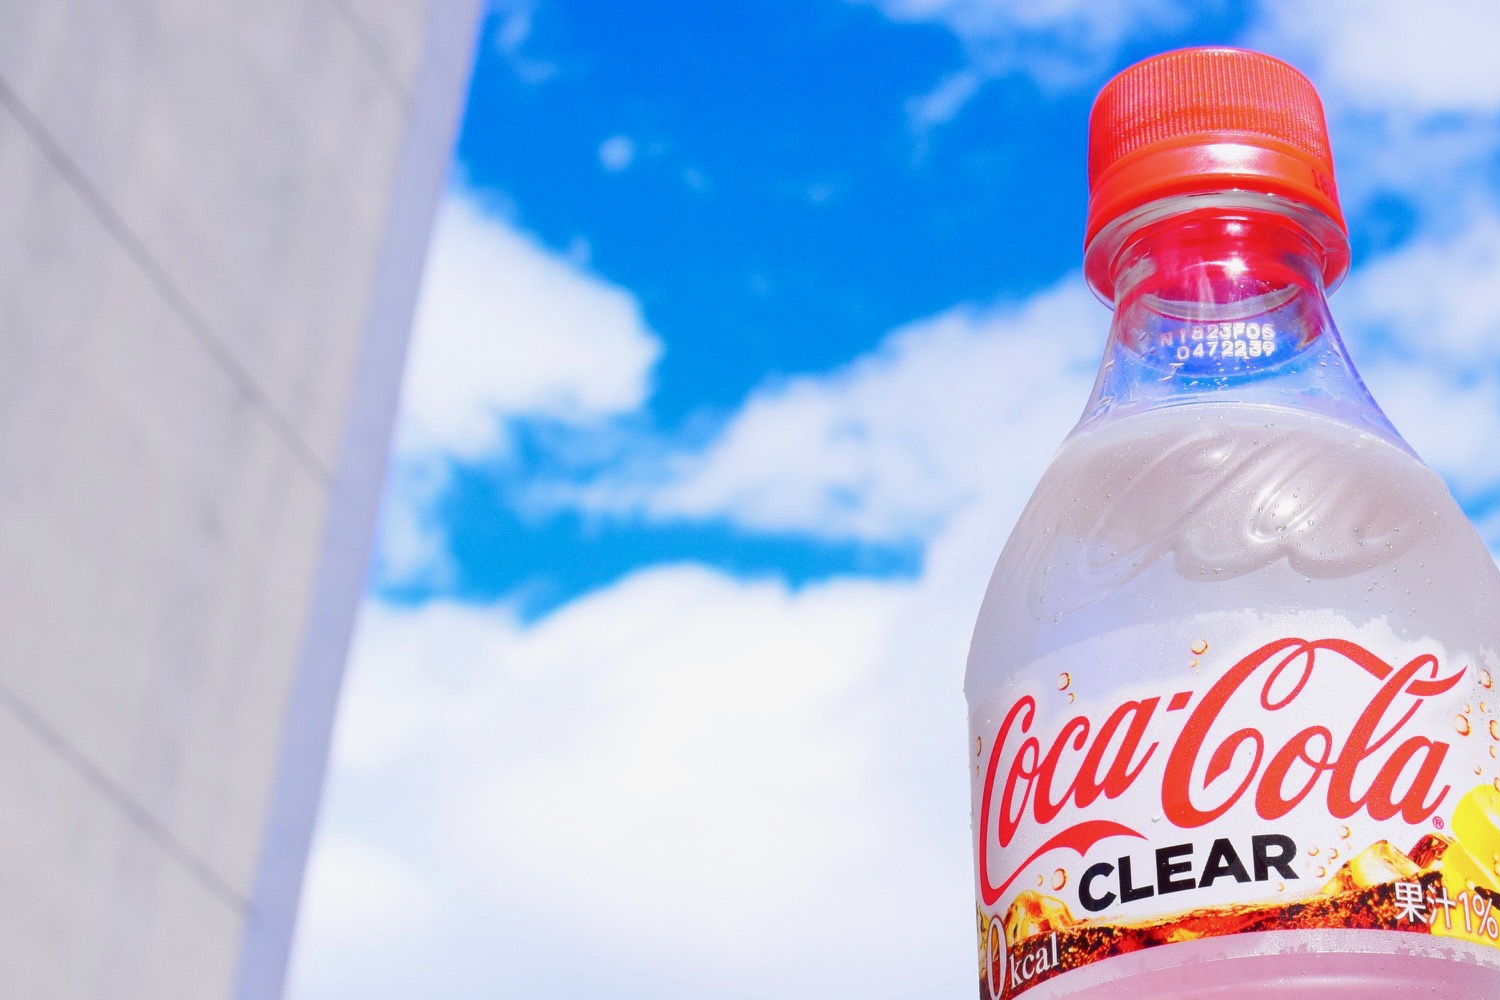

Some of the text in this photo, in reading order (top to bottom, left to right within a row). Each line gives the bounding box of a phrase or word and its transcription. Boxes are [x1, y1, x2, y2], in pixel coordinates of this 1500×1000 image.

[980, 637, 1468, 906] Coca-Cola
[1078, 834, 1300, 913] CLEAR
[1394, 881, 1499, 940] 果汁1%
[1009, 930, 1060, 990] kcal
